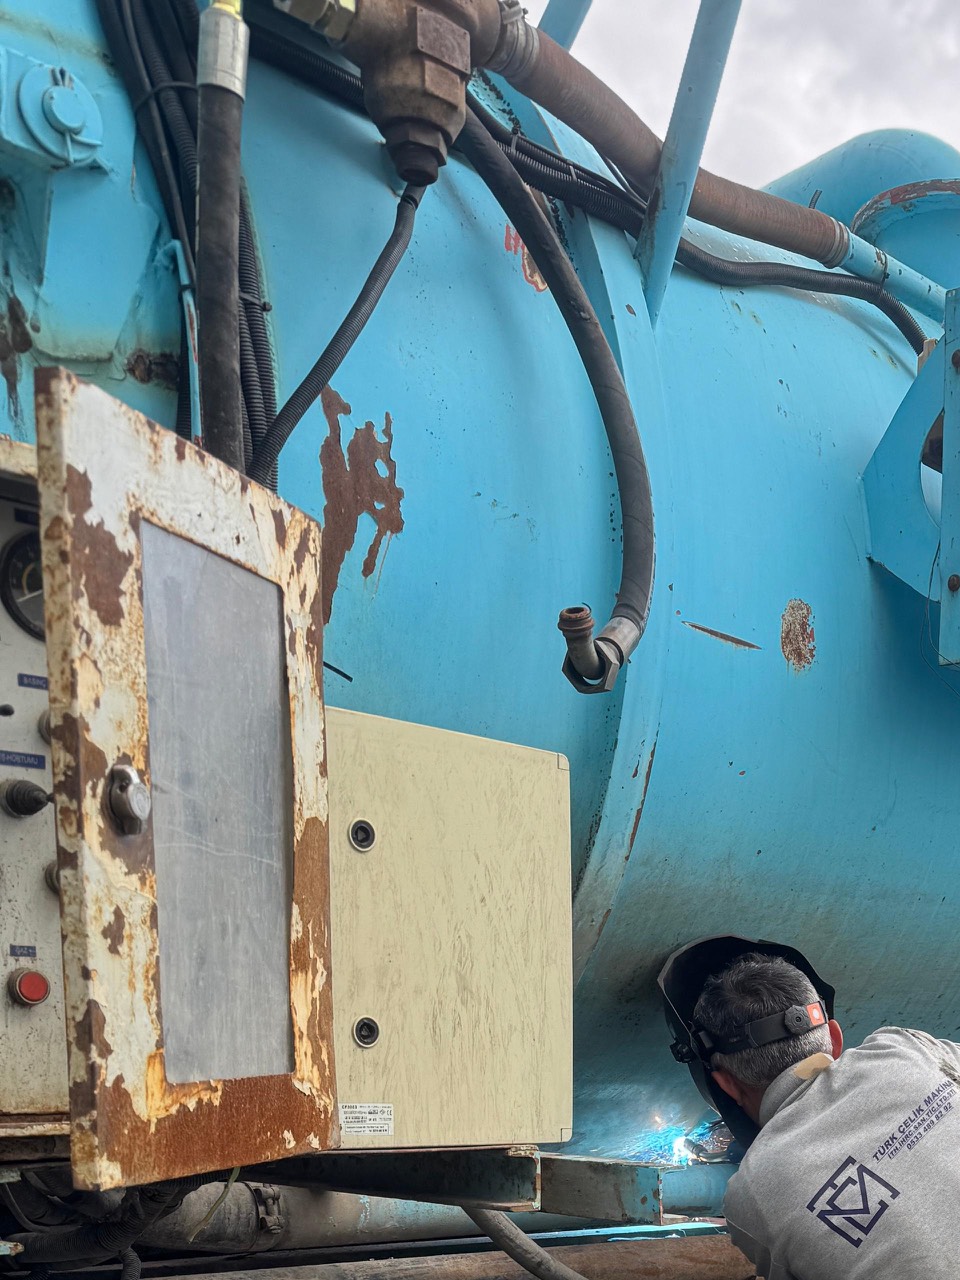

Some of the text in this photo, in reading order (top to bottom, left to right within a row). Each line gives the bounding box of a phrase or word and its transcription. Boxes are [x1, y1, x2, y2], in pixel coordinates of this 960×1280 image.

[872, 1080, 955, 1161] TÜRK ÇELİK MAKİNA
[906, 1131, 923, 1151] 0533
